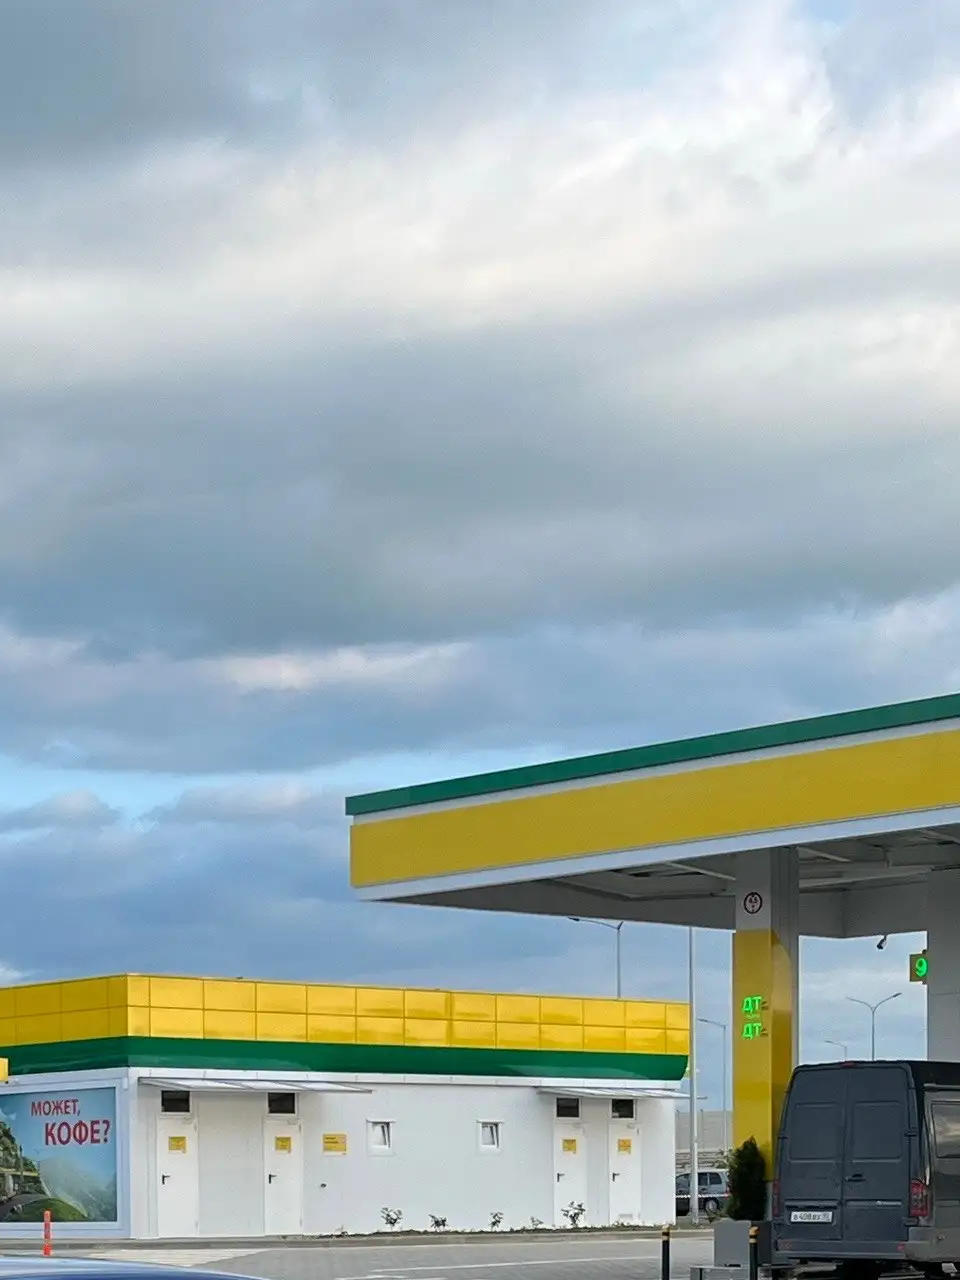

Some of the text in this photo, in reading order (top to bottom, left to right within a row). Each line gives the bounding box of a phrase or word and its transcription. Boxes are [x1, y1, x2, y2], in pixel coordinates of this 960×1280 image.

[742, 996, 762, 1012] ДТ
[742, 1022, 762, 1039] ДТ
[31, 1099, 81, 1117] МОЖЕТ,
[44, 1119, 111, 1146] КОФЕ?
